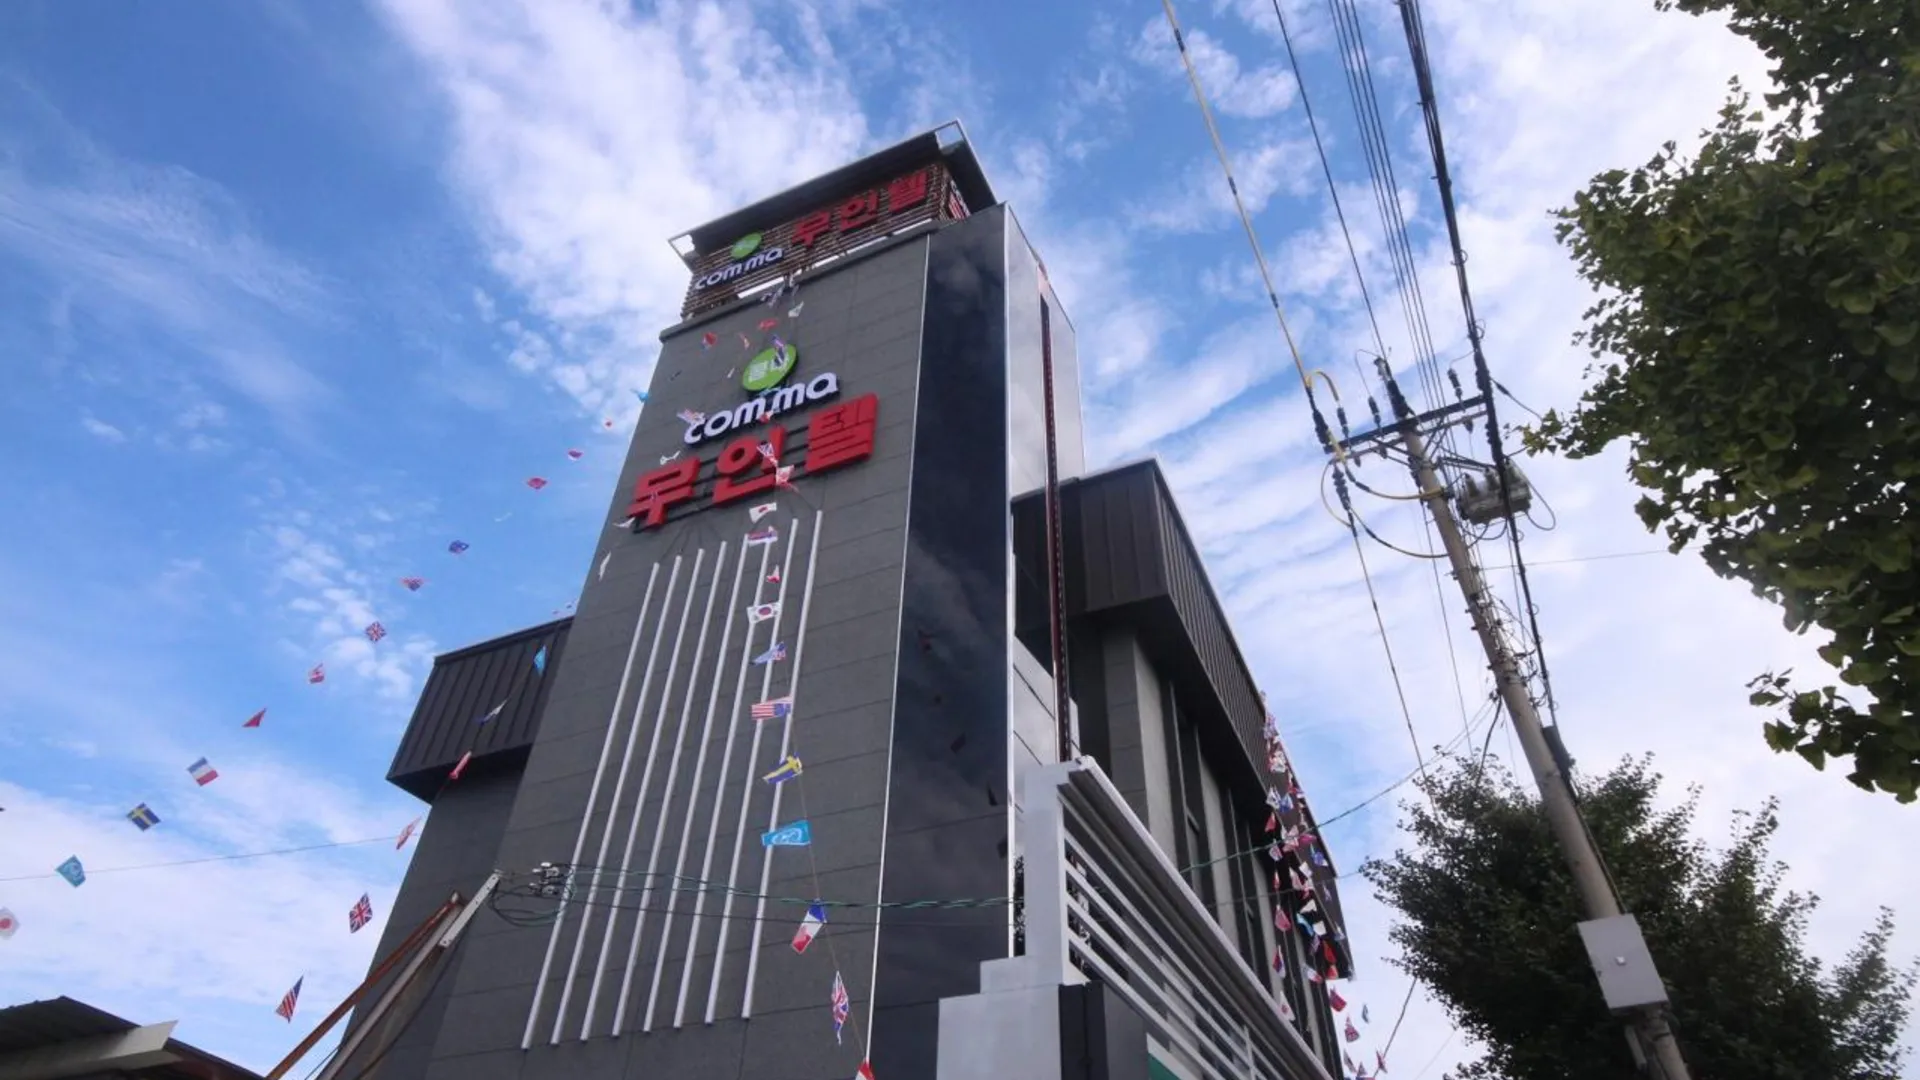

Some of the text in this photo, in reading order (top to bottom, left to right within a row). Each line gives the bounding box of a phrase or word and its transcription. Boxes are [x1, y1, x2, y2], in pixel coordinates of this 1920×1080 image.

[791, 171, 928, 248] 무인텔
[694, 248, 783, 290] comma
[683, 372, 840, 444] comma
[625, 392, 878, 526] 무인텔
